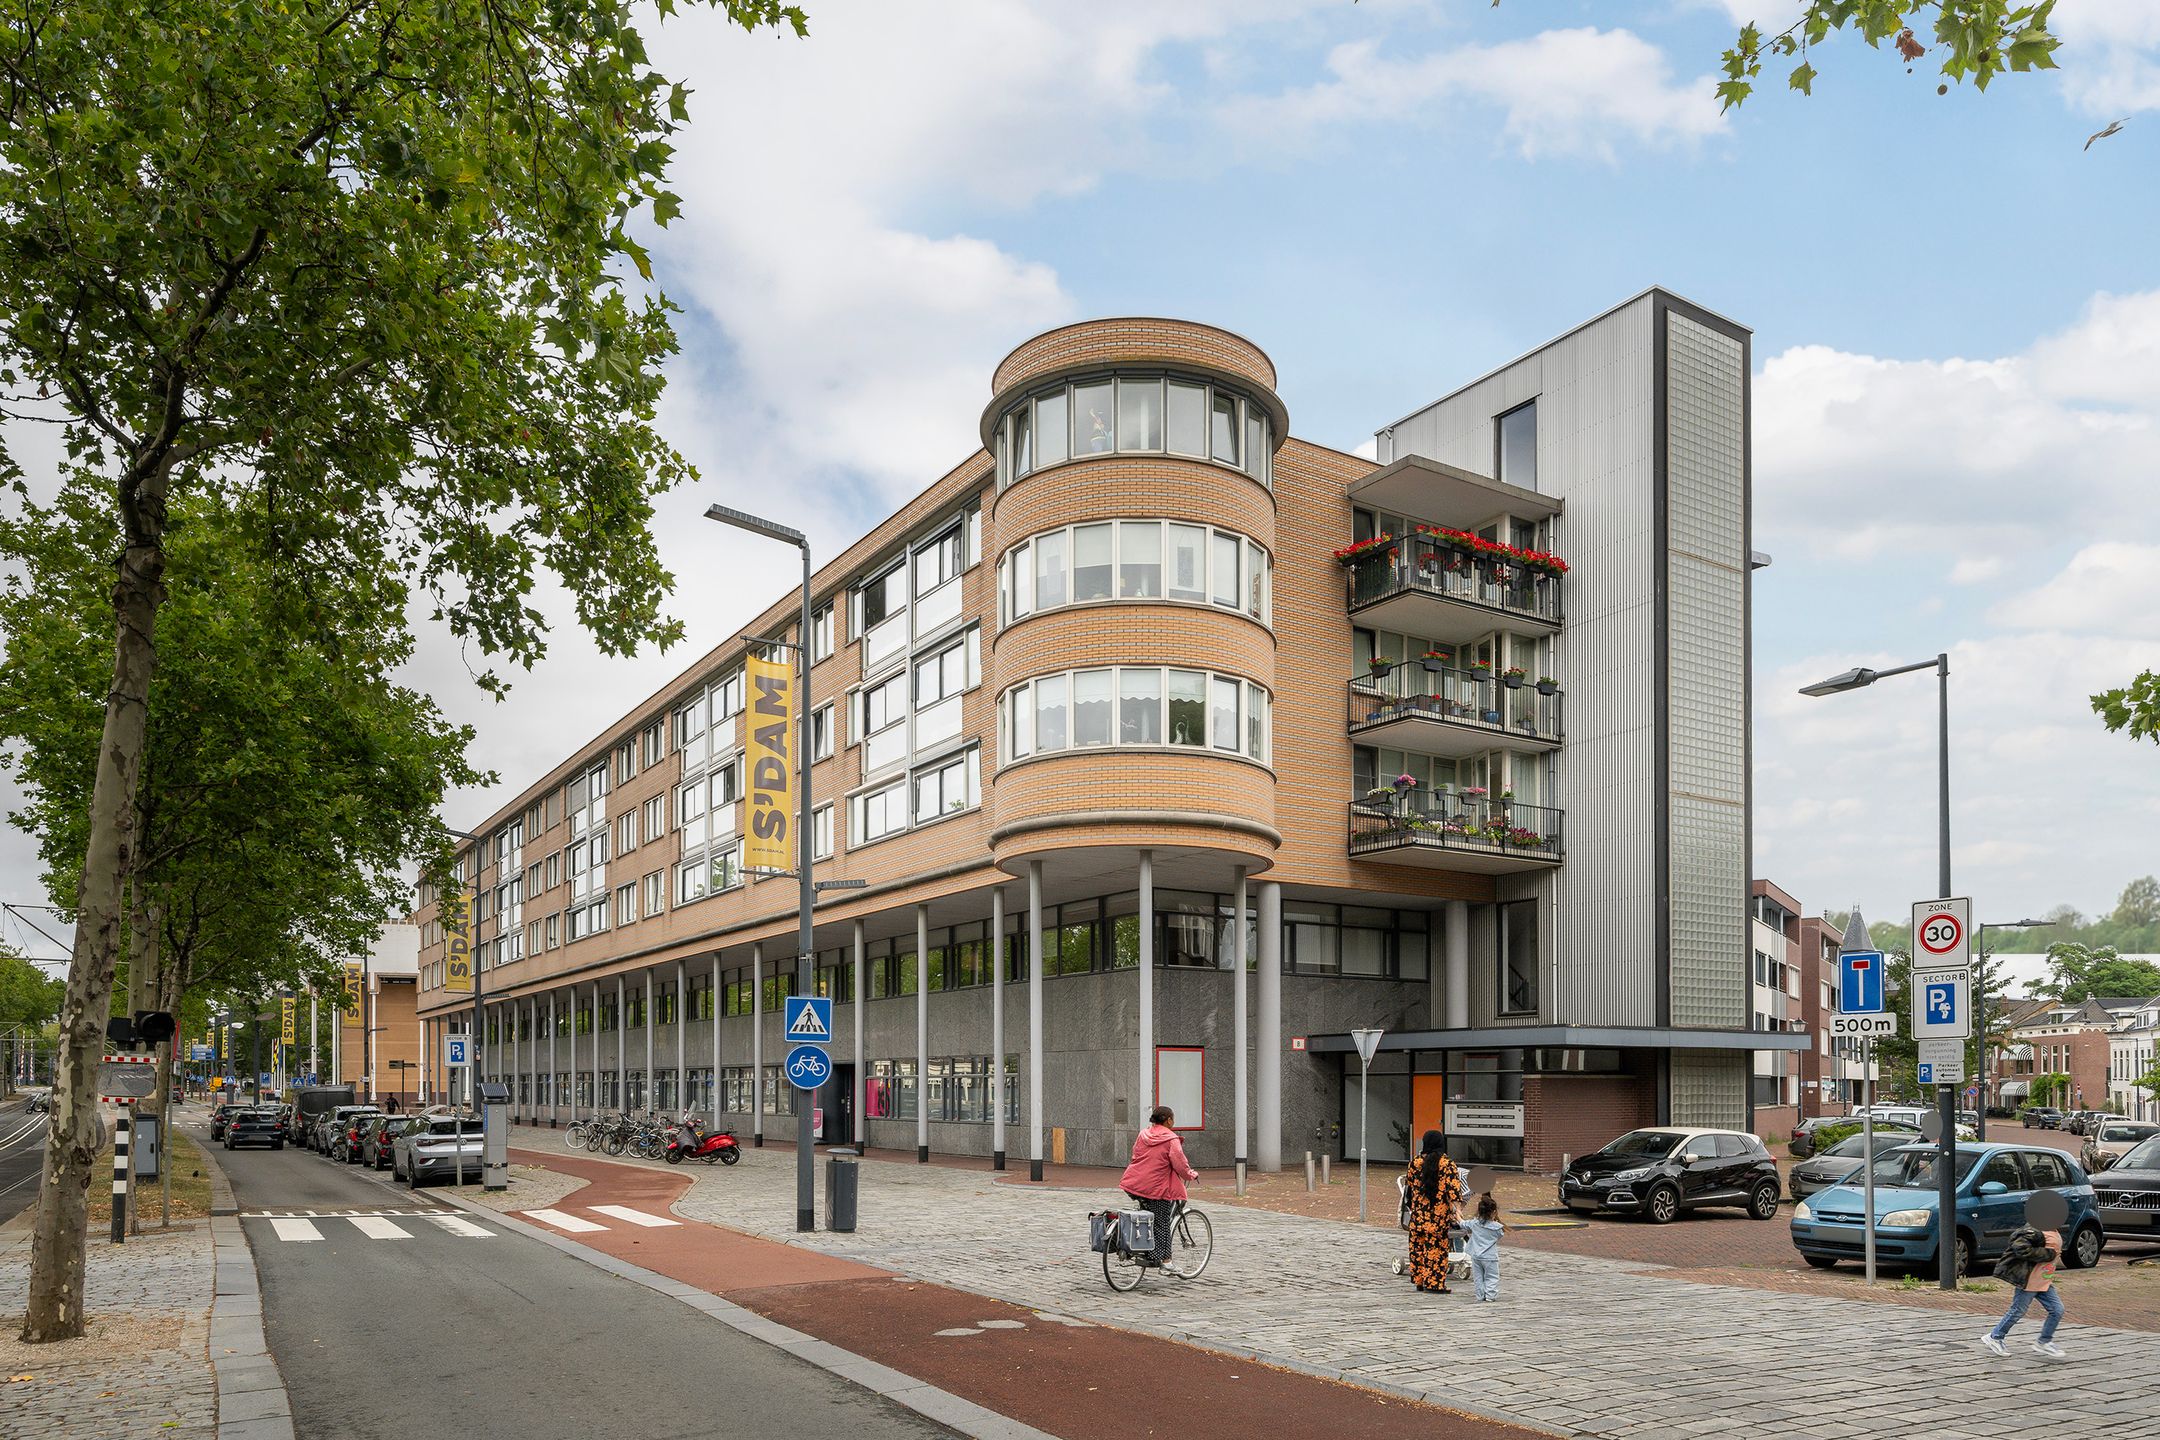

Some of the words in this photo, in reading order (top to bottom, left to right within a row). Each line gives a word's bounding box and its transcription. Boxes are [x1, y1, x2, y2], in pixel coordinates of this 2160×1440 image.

[752, 674, 787, 843] S'DAM
[1928, 903, 1953, 912] ZONE
[1927, 925, 1955, 942] 30
[1923, 974, 1958, 983] SECTOR
[1959, 972, 1966, 980] B
